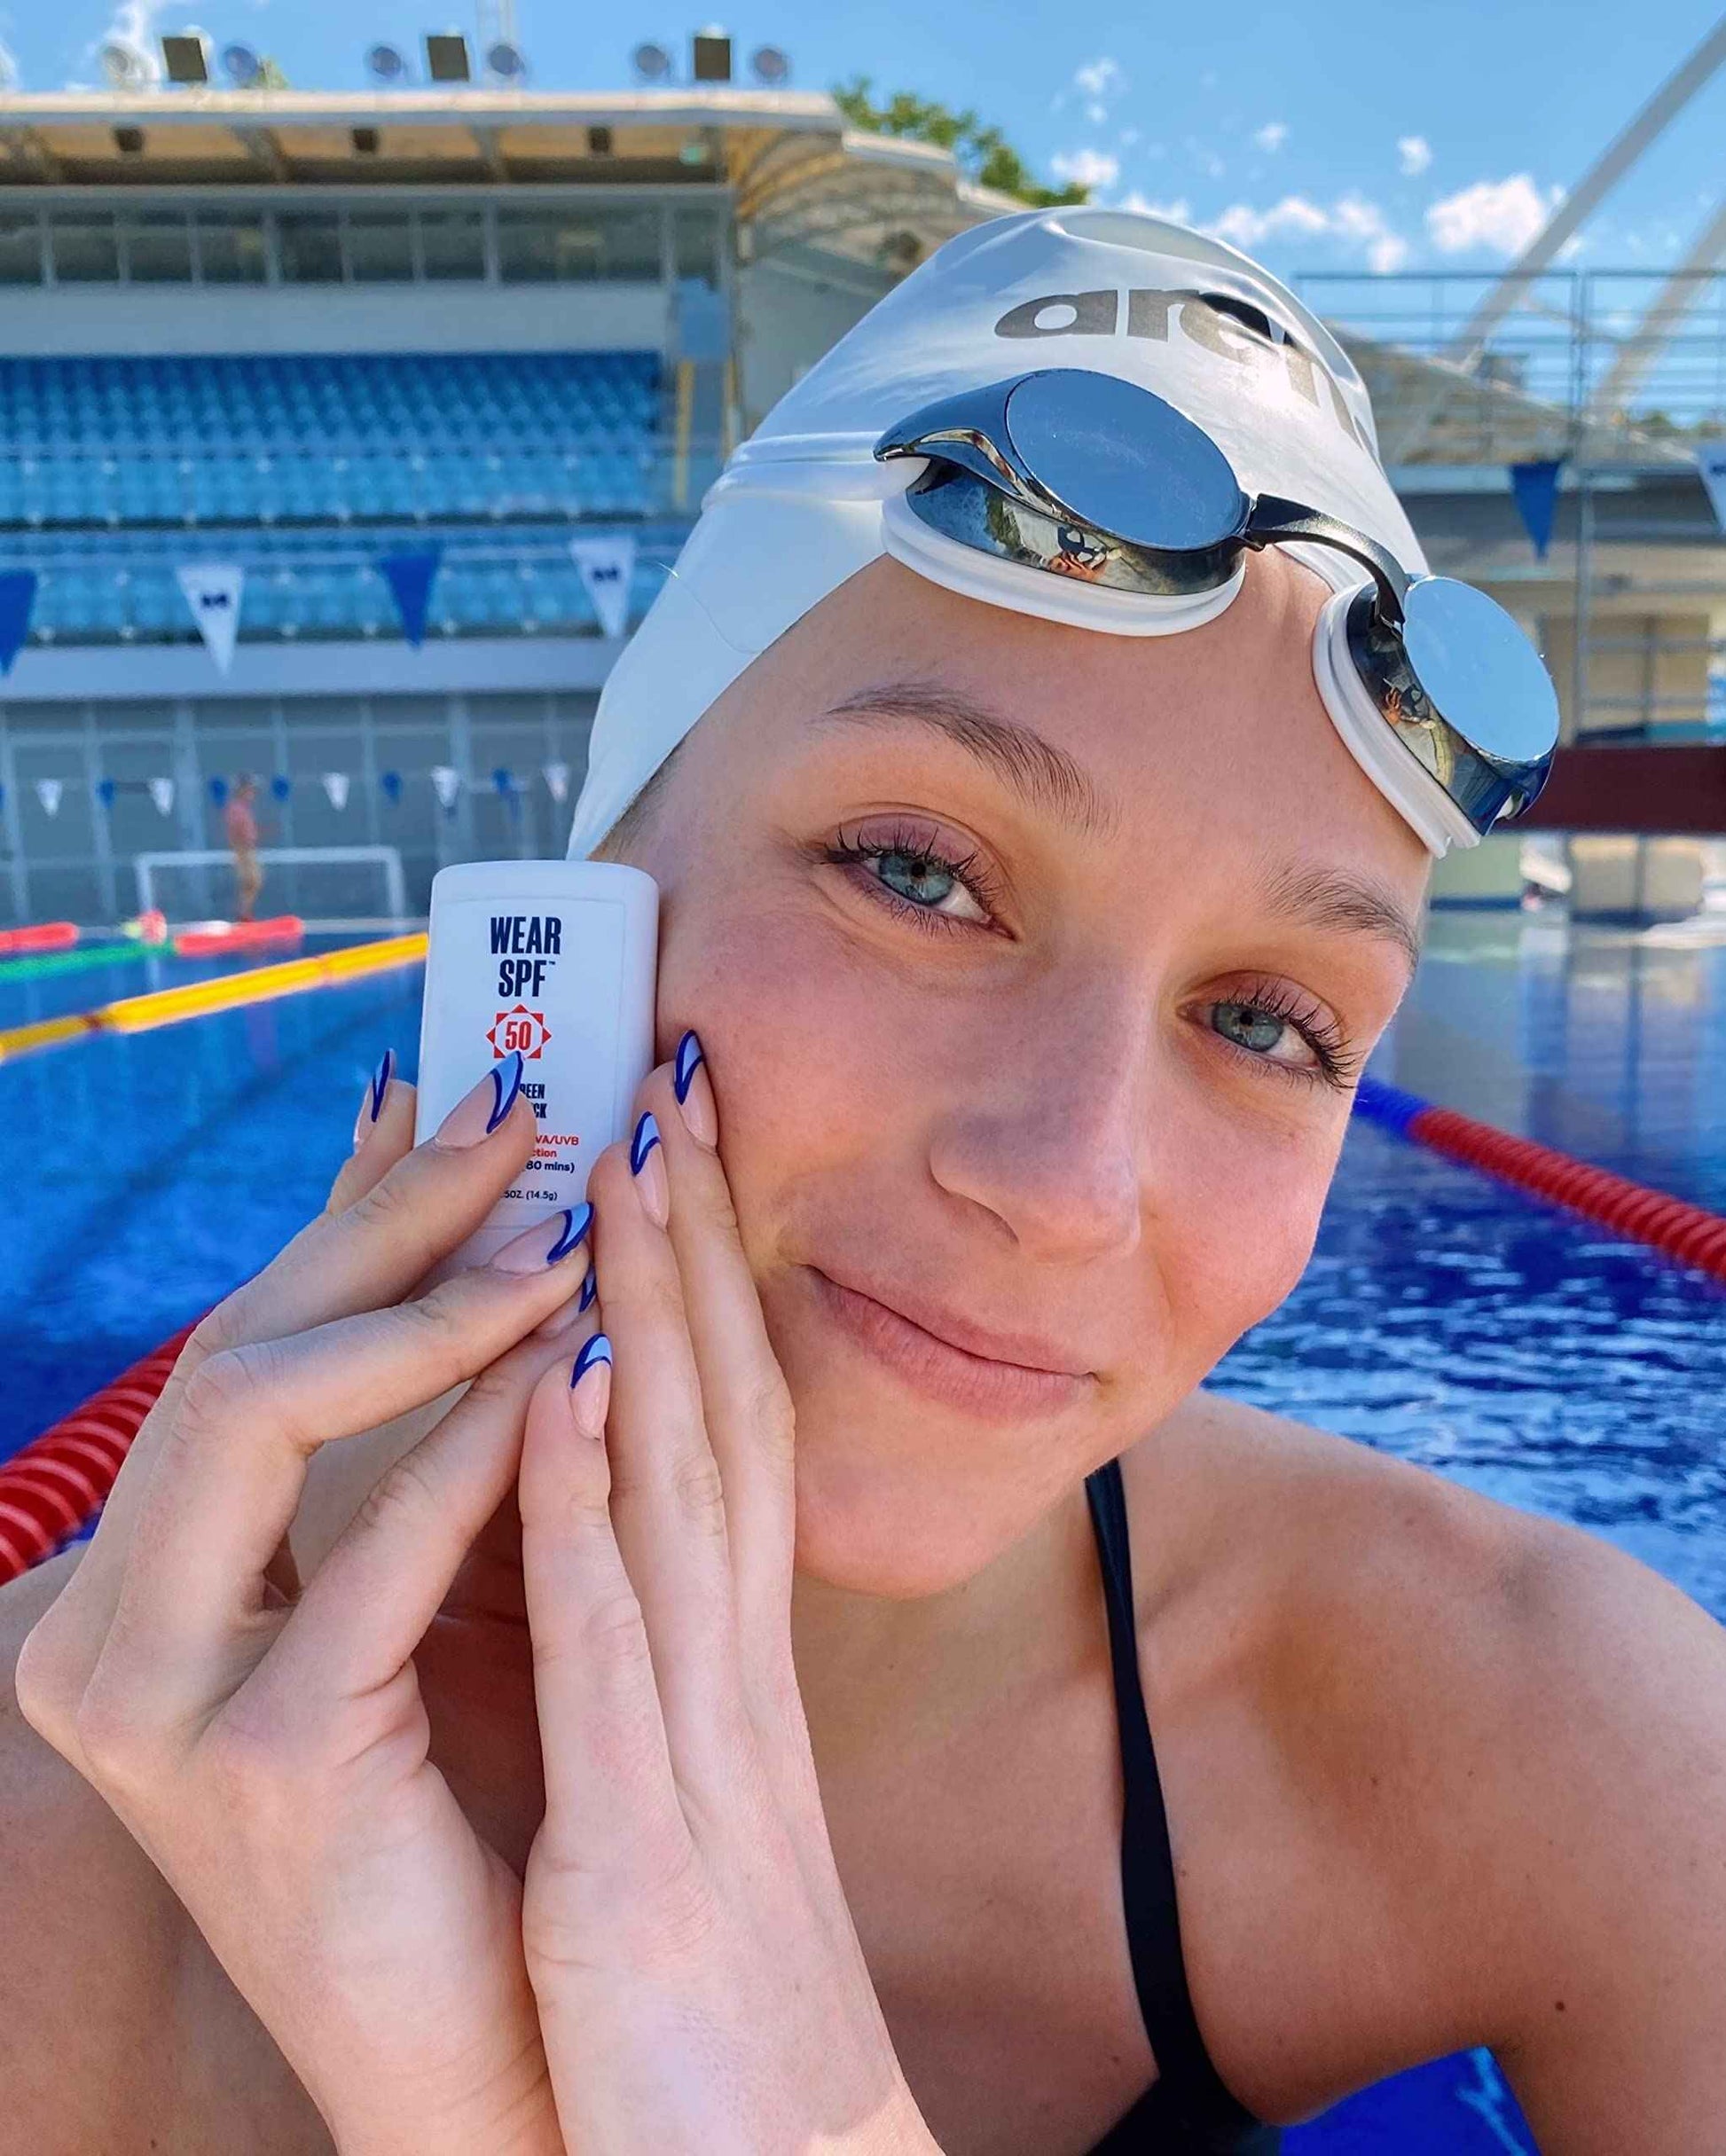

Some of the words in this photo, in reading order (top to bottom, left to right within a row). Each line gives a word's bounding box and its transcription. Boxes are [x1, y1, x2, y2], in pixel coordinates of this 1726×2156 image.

[490, 916, 561, 954] WEAR
[505, 1021, 532, 1051] 50
[519, 1083, 545, 1100] REEN
[532, 1102, 547, 1119] CK
[535, 1135, 580, 1147] VA/UVB
[525, 1160, 542, 1171] 80
[544, 1162, 576, 1174] mins)
